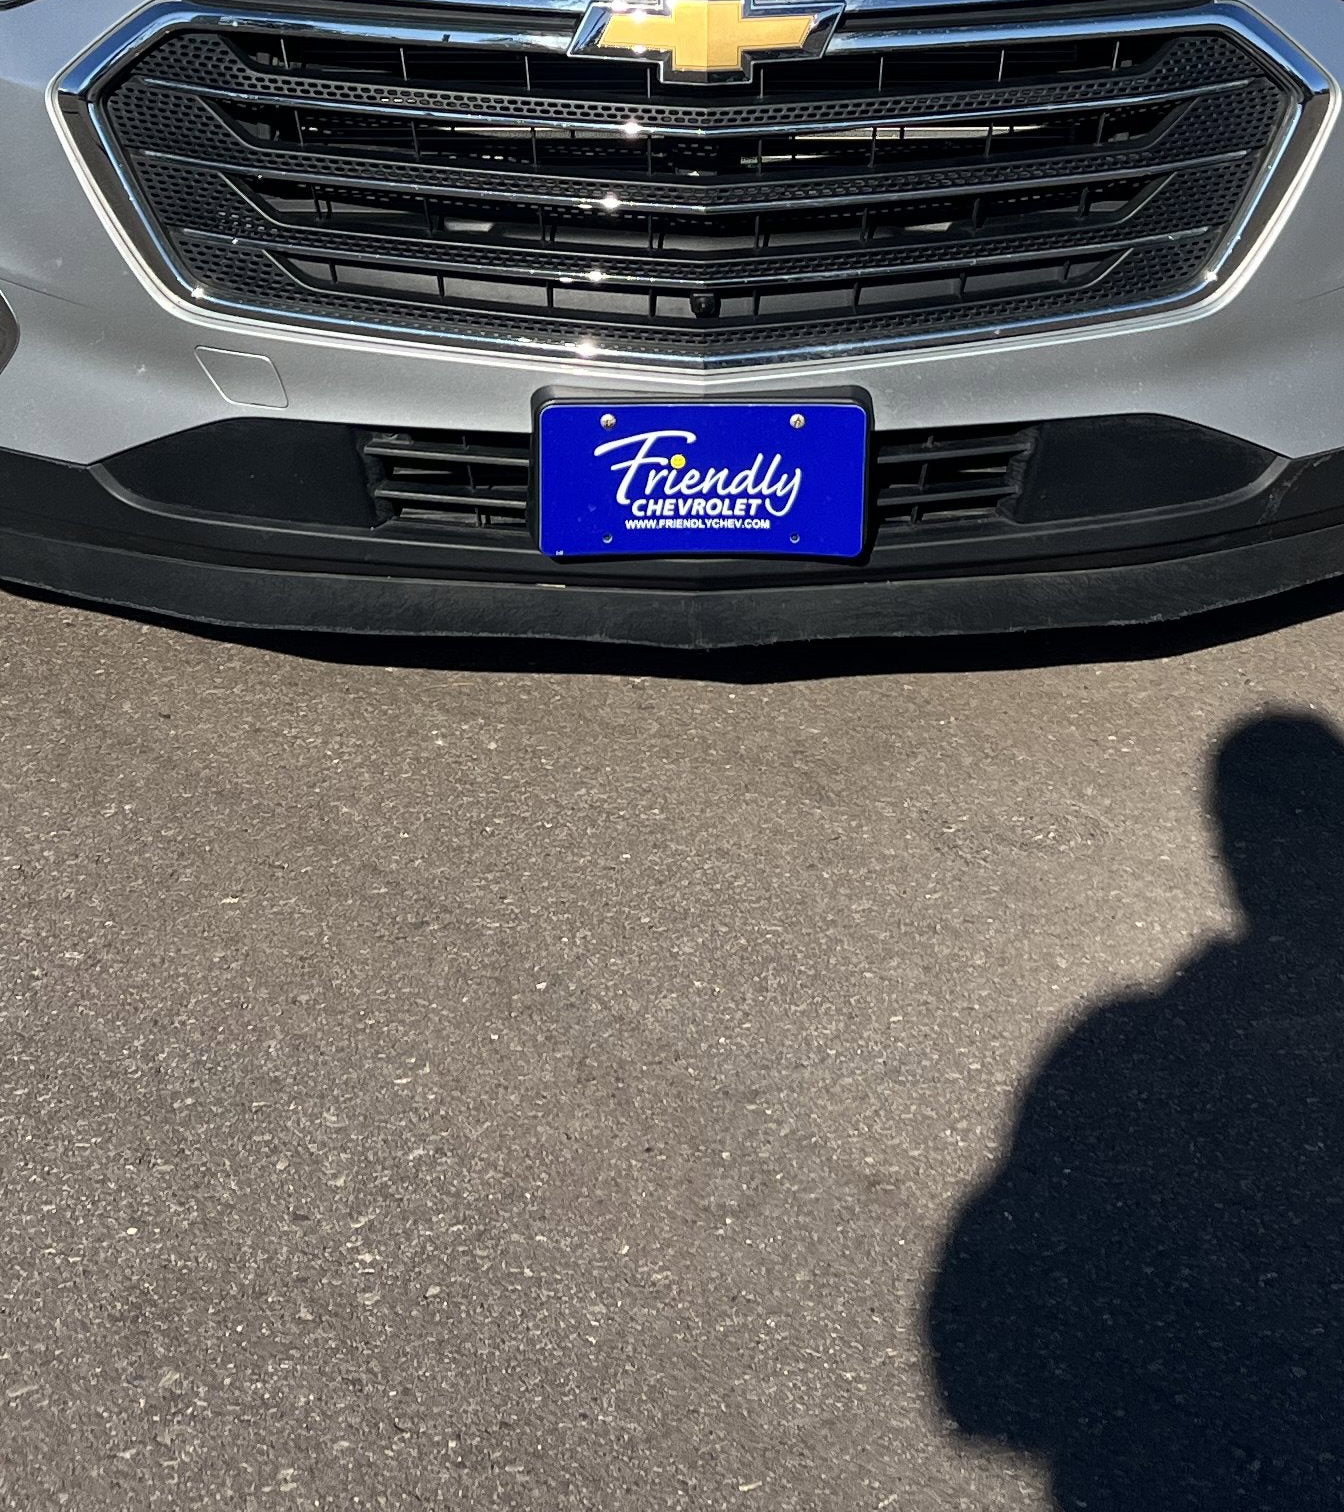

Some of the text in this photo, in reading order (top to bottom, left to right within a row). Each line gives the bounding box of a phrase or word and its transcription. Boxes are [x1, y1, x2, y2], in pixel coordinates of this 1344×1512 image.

[594, 430, 802, 517] Friendly
[632, 498, 762, 516] CHEVROLET
[625, 518, 771, 530] WWW.FRIENDLYCHEV.COM
